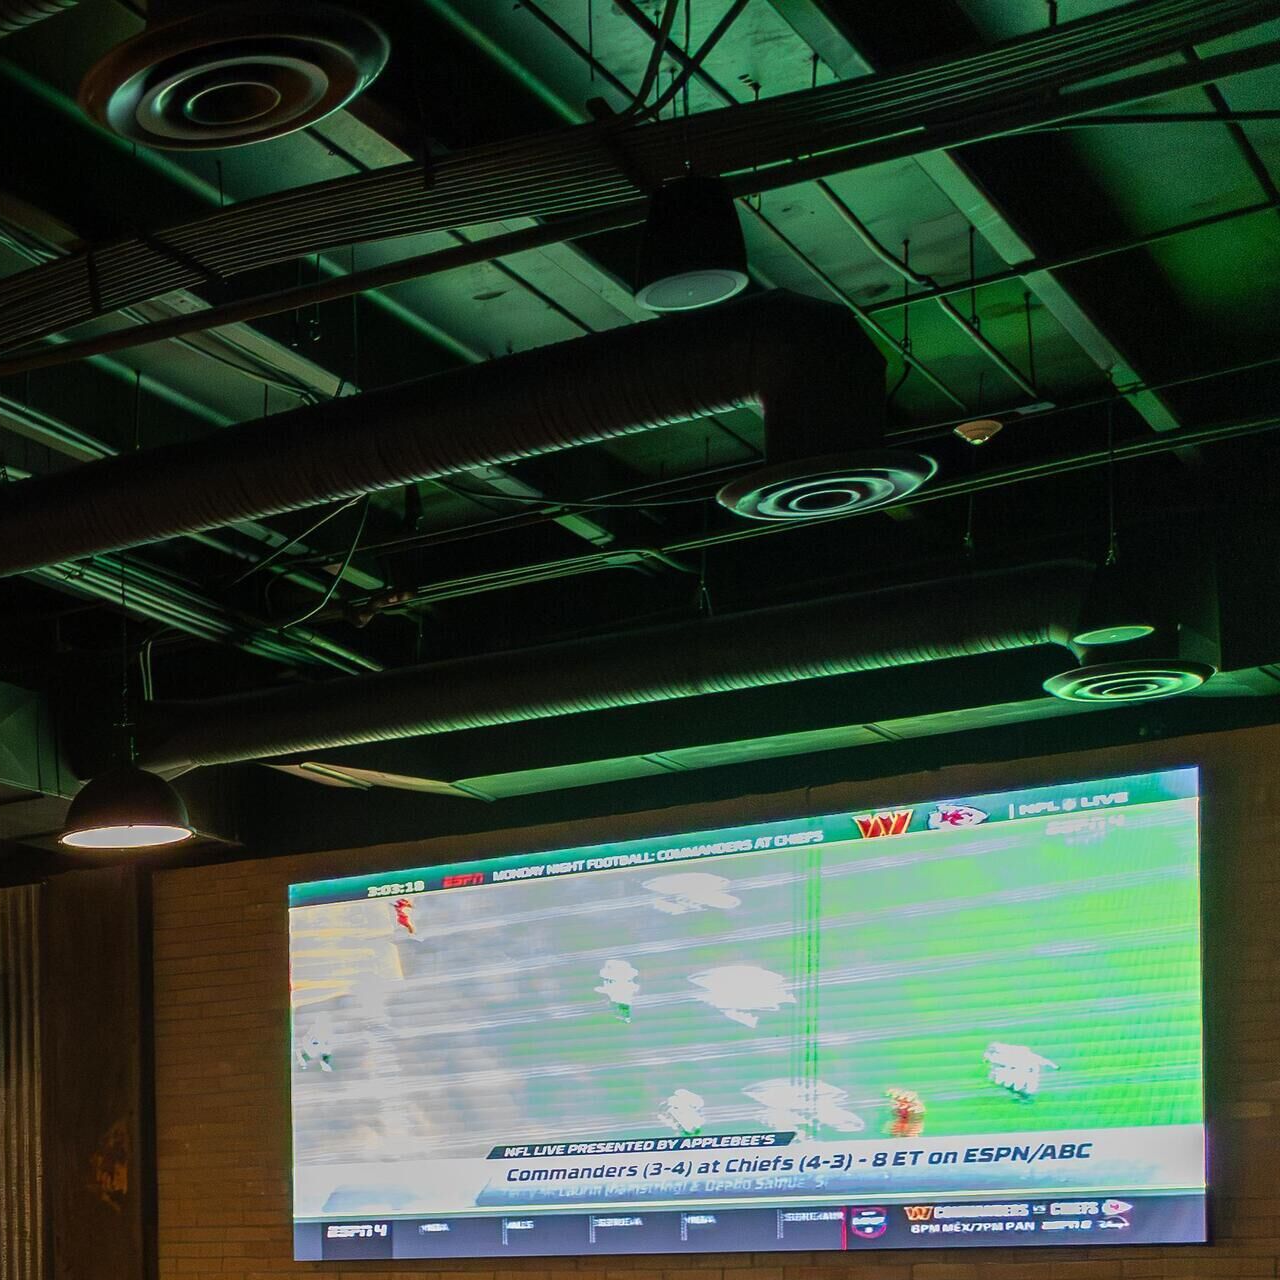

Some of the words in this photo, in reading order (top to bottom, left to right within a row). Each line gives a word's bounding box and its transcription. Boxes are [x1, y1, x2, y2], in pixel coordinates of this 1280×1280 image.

[1081, 792, 1129, 808] LIVE
[493, 866, 545, 881] MONDAY
[546, 860, 585, 875] NIGHT
[587, 852, 655, 869] FOOTBALL:
[657, 840, 752, 861] COMMANDERS
[754, 837, 773, 849] AT
[774, 830, 824, 847] CHIEFS
[443, 872, 484, 888] ESPN
[504, 1147, 531, 1158] NFL
[533, 1145, 565, 1156] LIVE
[567, 1140, 653, 1155] PRESENTED
[656, 1139, 677, 1151] BY
[680, 1134, 776, 1150] APPLEBEE'S
[507, 1164, 638, 1182] Commanders
[642, 1160, 693, 1180] (3-4)
[697, 1160, 721, 1175] at
[725, 1155, 793, 1174] Chiefs
[798, 1153, 852, 1172] (4-3)
[872, 1152, 888, 1168] 8
[892, 1150, 925, 1167] ET
[929, 1150, 958, 1165] on
[963, 1143, 1093, 1164] ESPN/ABC
[327, 1225, 373, 1238] ESPN
[1006, 1222, 1035, 1232] PAN
